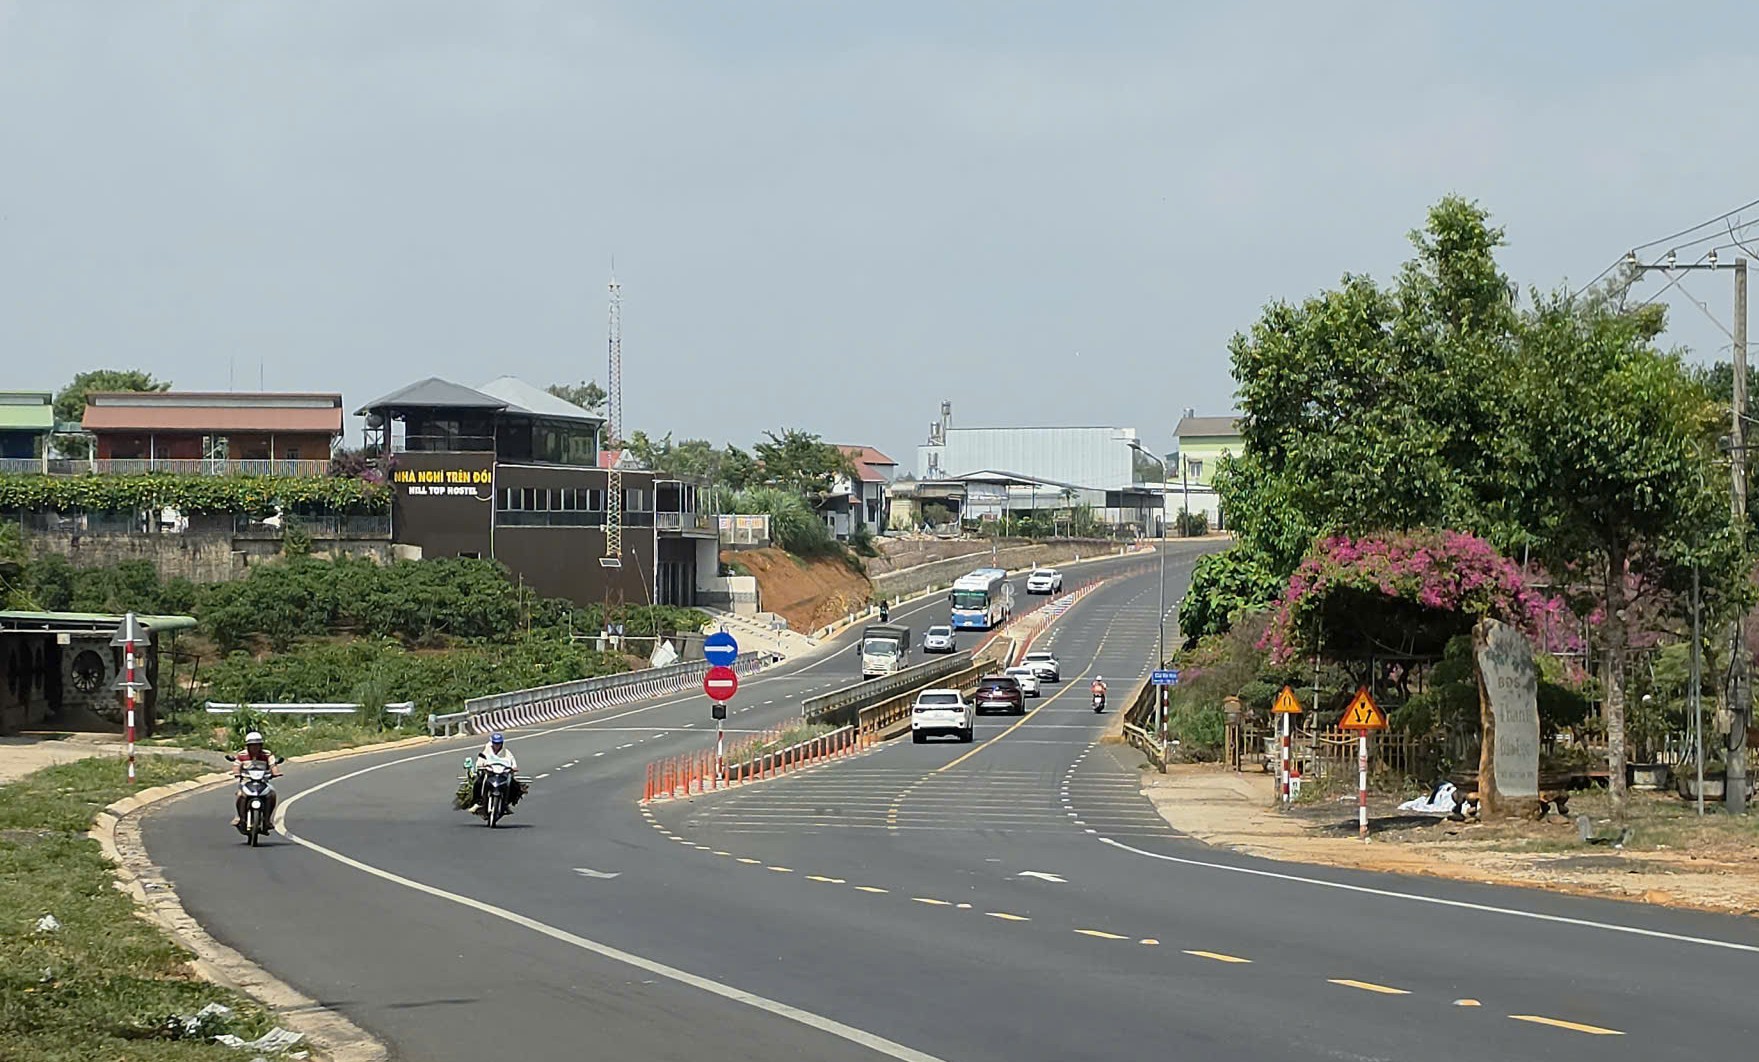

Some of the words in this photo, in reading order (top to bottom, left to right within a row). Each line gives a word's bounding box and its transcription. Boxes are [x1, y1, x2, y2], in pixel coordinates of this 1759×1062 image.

[408, 486, 428, 495] HILL
[428, 486, 445, 495] TOP
[447, 486, 478, 495] HOSTEL
